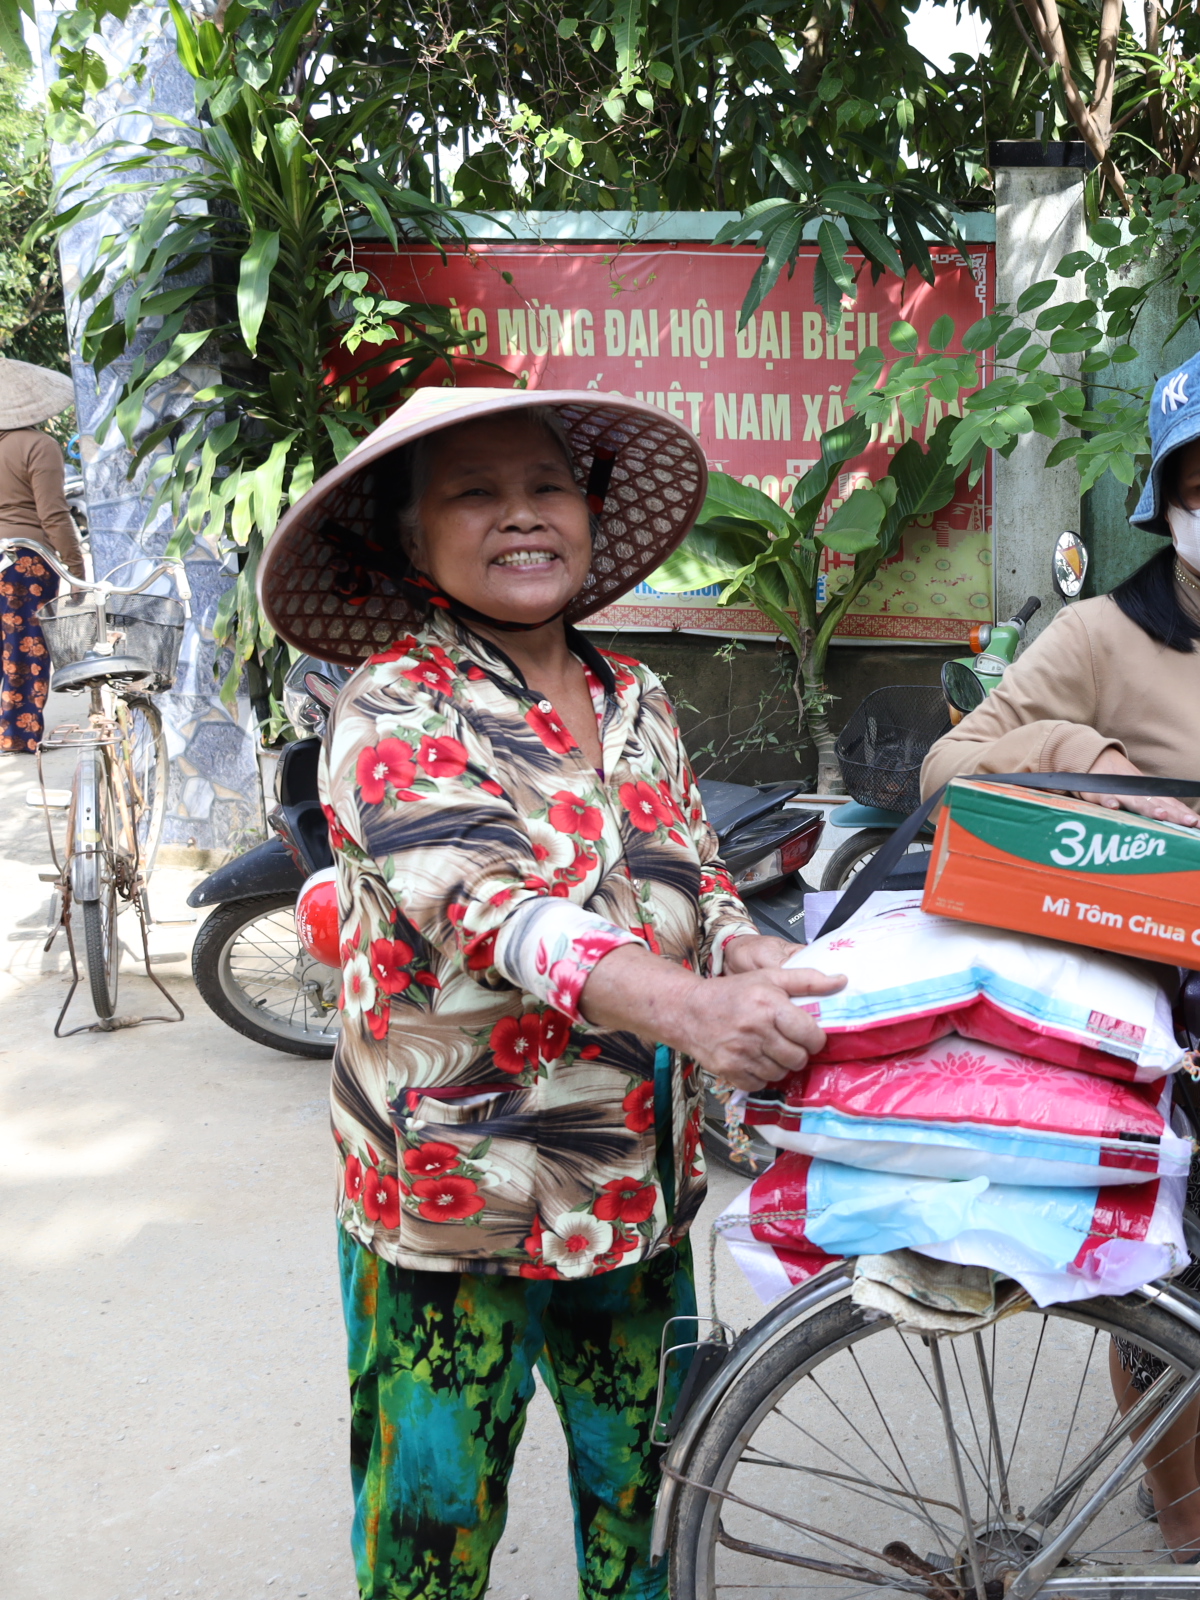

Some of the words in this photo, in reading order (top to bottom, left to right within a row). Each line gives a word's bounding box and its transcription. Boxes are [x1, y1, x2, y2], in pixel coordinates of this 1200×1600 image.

[497, 299, 595, 357] MỪNG
[604, 309, 659, 368] ĐẠI
[669, 299, 725, 369] HỘI
[736, 311, 791, 370] ĐẠI
[714, 392, 791, 441] NAM
[802, 385, 846, 442] XÃ
[788, 910, 806, 925] HON
[1042, 895, 1070, 917] Mì
[1076, 902, 1123, 929] Tôm
[1128, 915, 1185, 943] Chua
